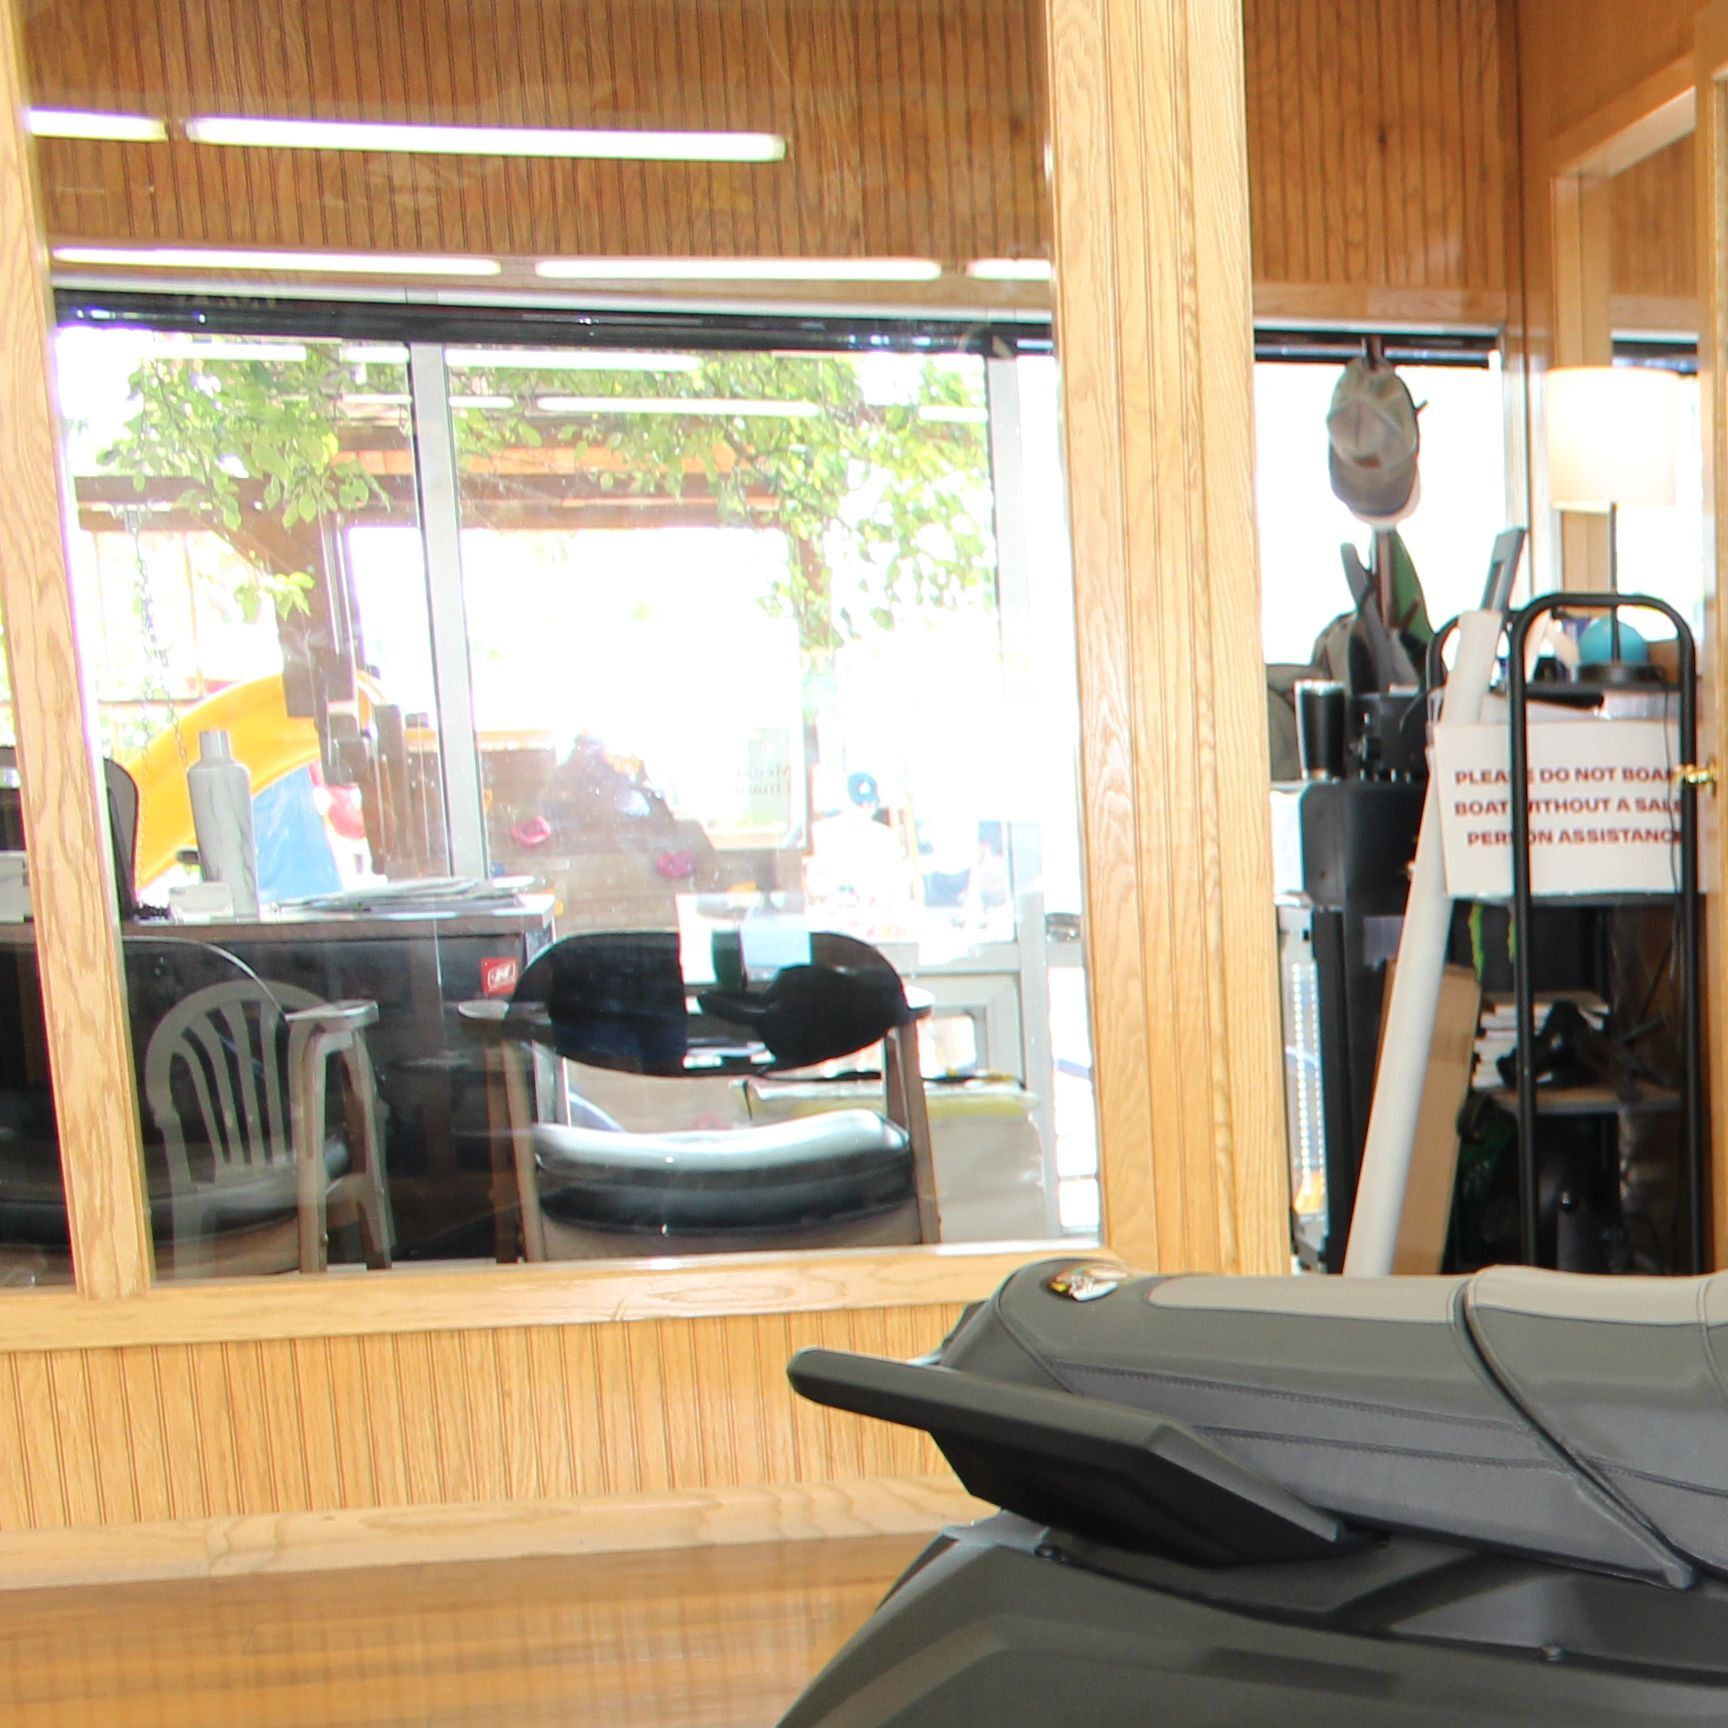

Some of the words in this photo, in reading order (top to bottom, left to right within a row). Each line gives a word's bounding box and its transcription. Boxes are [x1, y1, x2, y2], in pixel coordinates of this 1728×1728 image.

[1455, 767, 1535, 785] PLEAE
[1540, 766, 1571, 783] DO
[1575, 766, 1617, 782] NOT
[1455, 798, 1508, 816] BOAT
[1617, 797, 1631, 812] A
[1467, 828, 1553, 847] PERON
